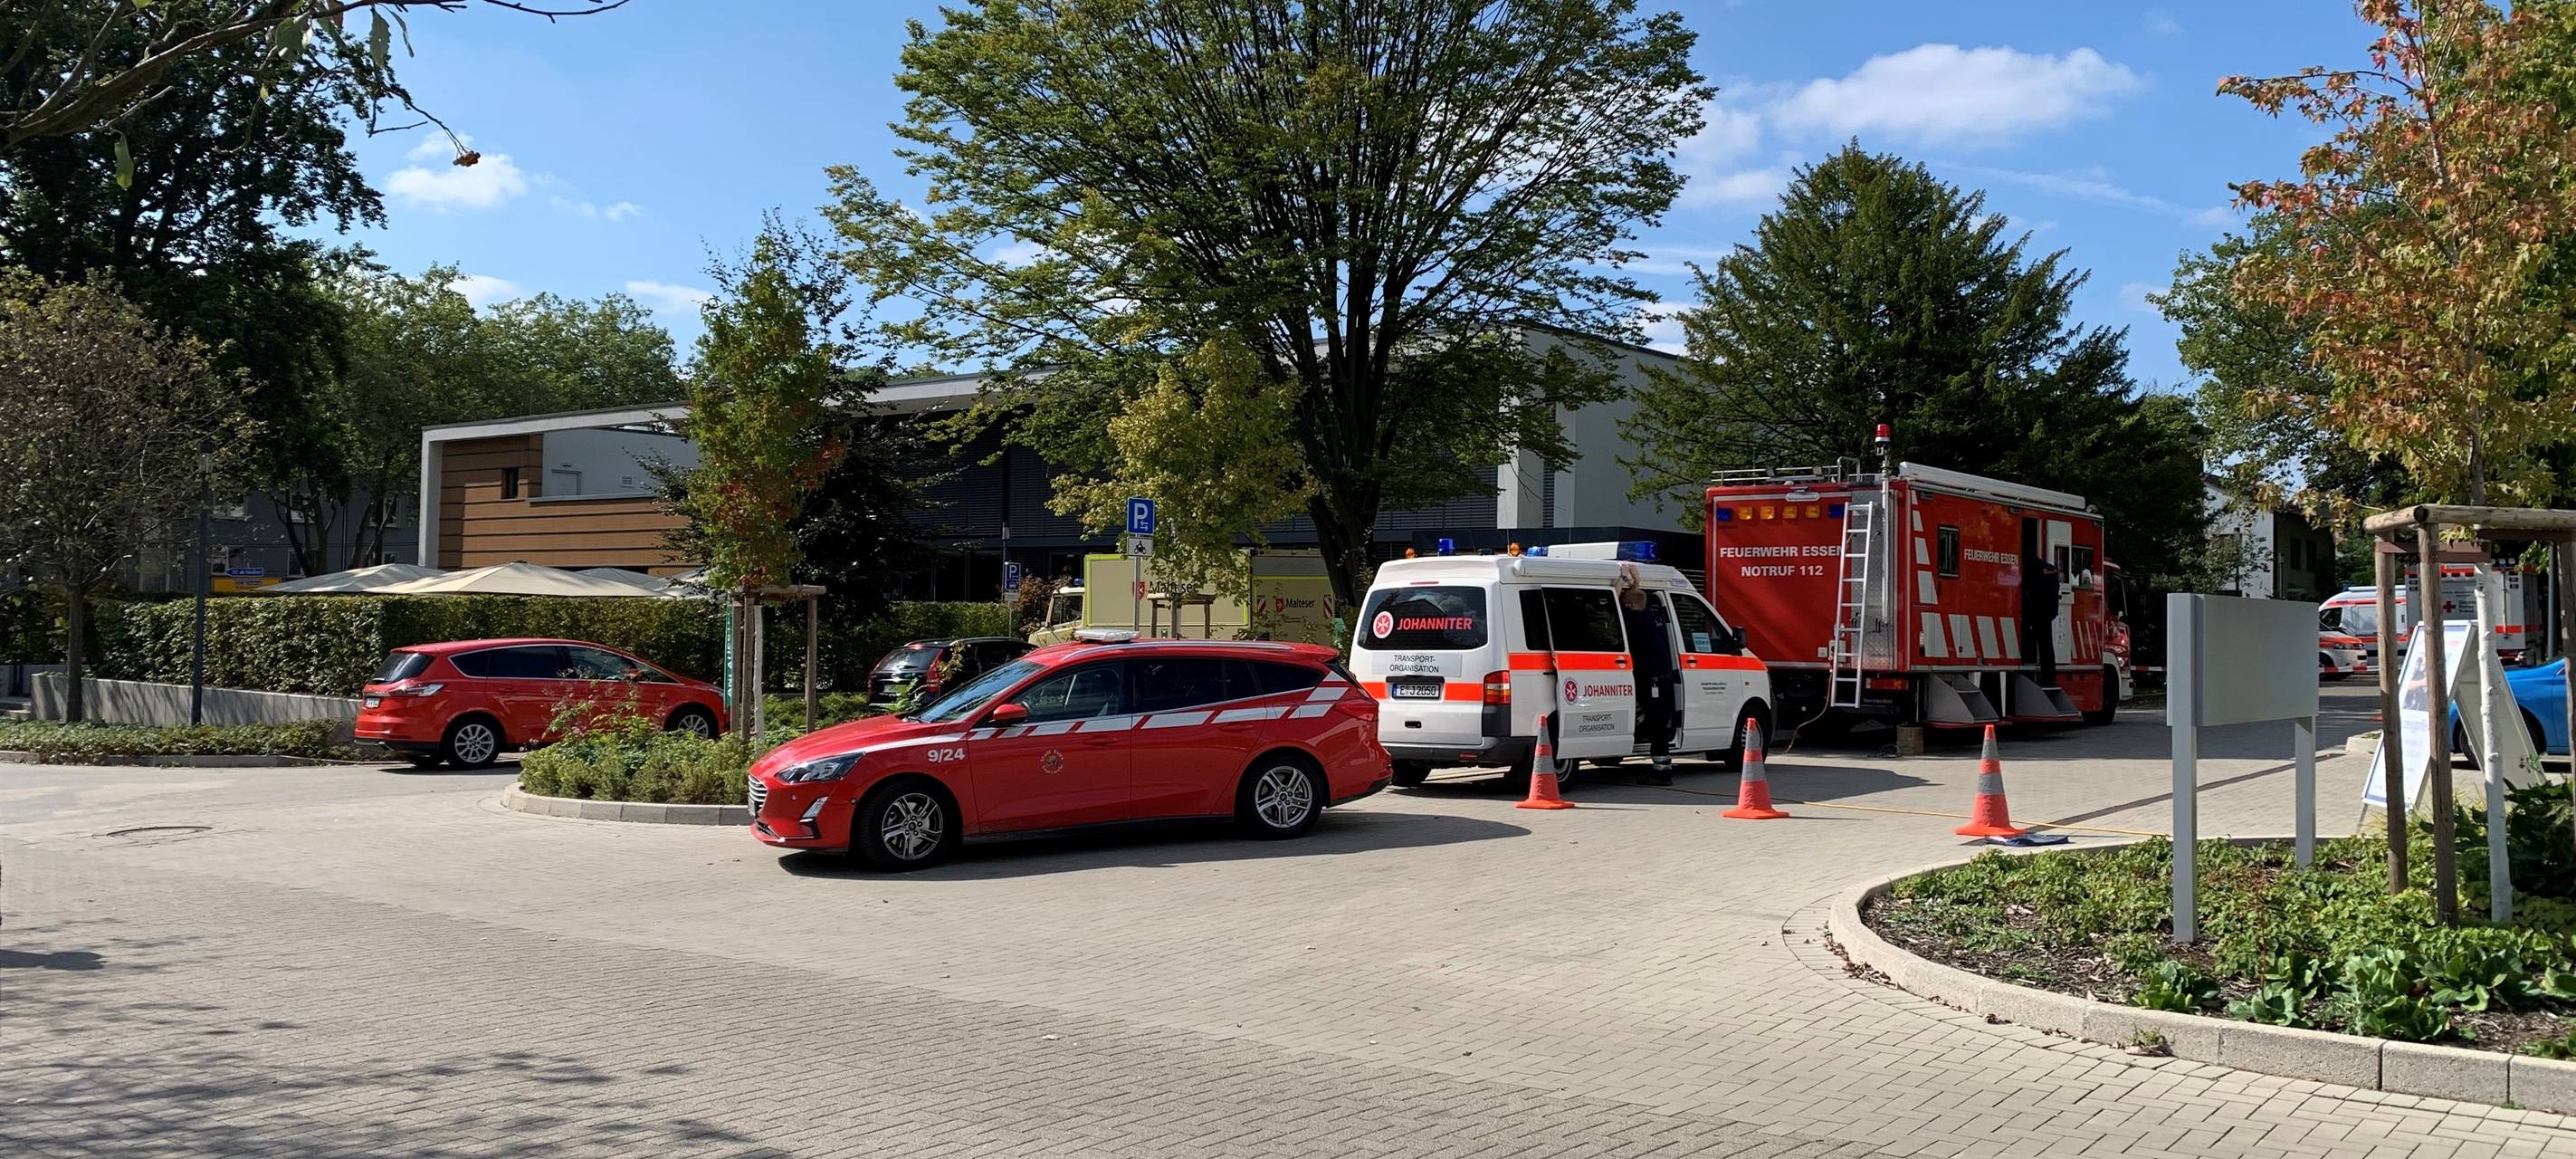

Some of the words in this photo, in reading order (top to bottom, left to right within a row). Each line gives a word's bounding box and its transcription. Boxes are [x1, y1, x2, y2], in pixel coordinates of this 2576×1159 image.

[1133, 503, 1149, 530] P
[1720, 546, 1798, 558] FEUERWEHR
[1964, 548, 1999, 563] FEUERWEHR
[2000, 552, 2019, 566] ESSEN
[1741, 566, 1795, 577] NOTRUF
[1799, 565, 1823, 576] 112
[1285, 598, 1315, 608] Malteser
[1397, 618, 1473, 630] JOHANNITER
[1394, 655, 1436, 663] TRANSPORT-
[1389, 664, 1439, 673] ORGANISATION
[1583, 685, 1634, 697] JOHANNITER
[1582, 714, 1613, 723] TRANSPORT-
[1579, 723, 1616, 733] ORGANISATION
[927, 748, 965, 763] 9/24
